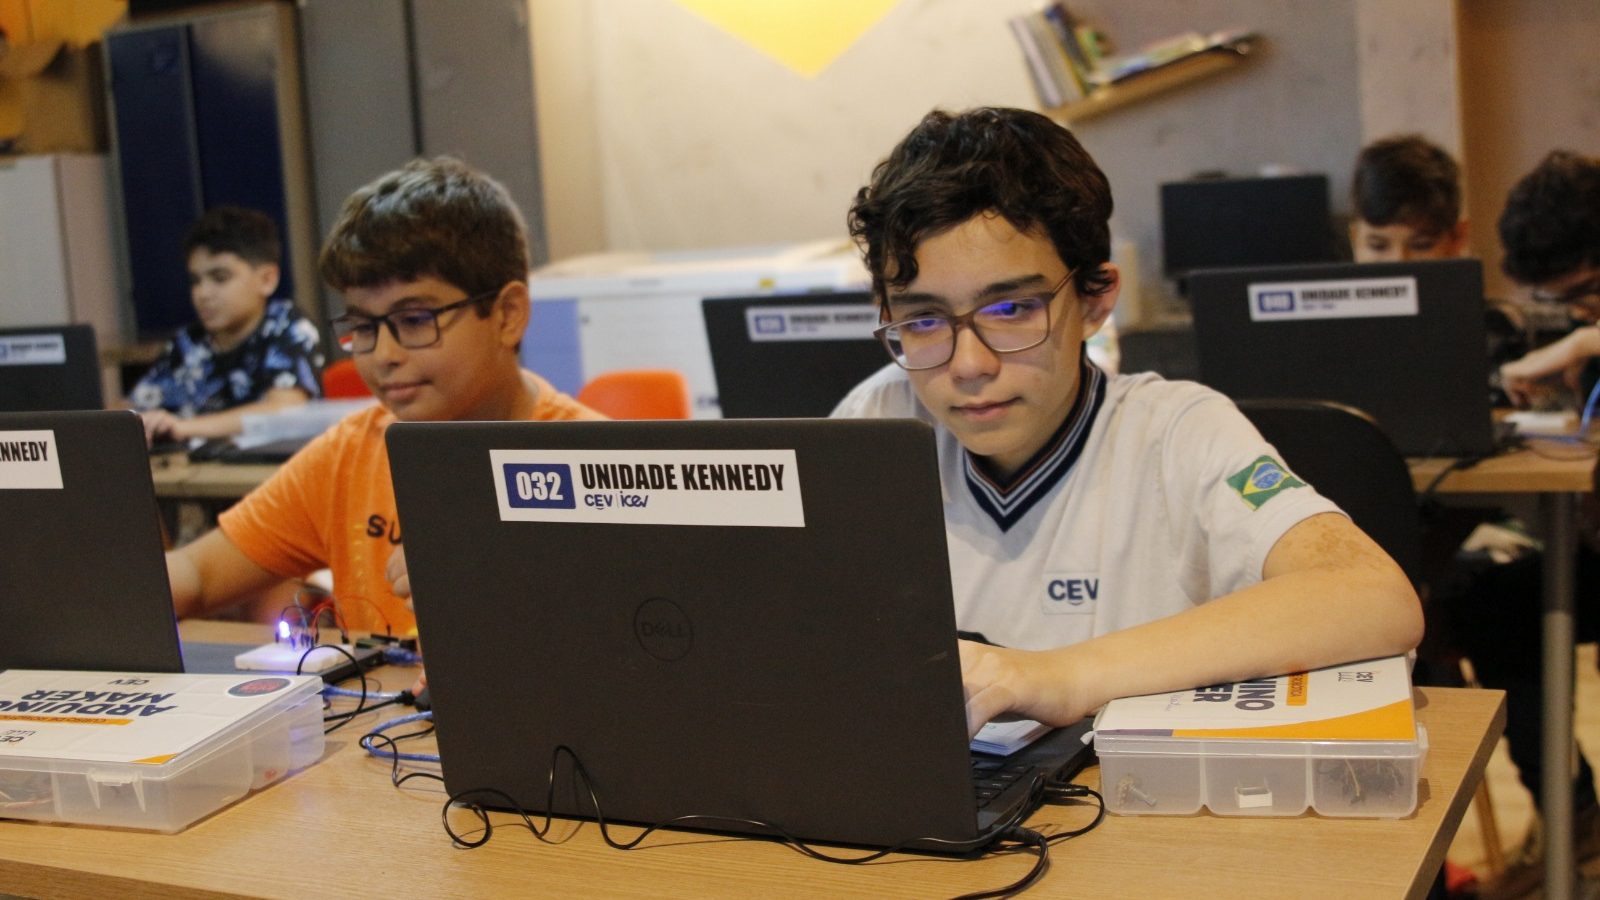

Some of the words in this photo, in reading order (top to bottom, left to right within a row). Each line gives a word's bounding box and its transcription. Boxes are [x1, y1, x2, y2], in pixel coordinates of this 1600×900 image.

[0, 441, 48, 462] NNEDY
[515, 471, 563, 501] 032
[580, 463, 678, 490] UNIDADE
[682, 464, 784, 491] KENNEDY
[584, 494, 613, 508] CEV
[1047, 578, 1099, 602] CEV
[21, 690, 176, 704] MAKER
[0, 735, 25, 743] CE
